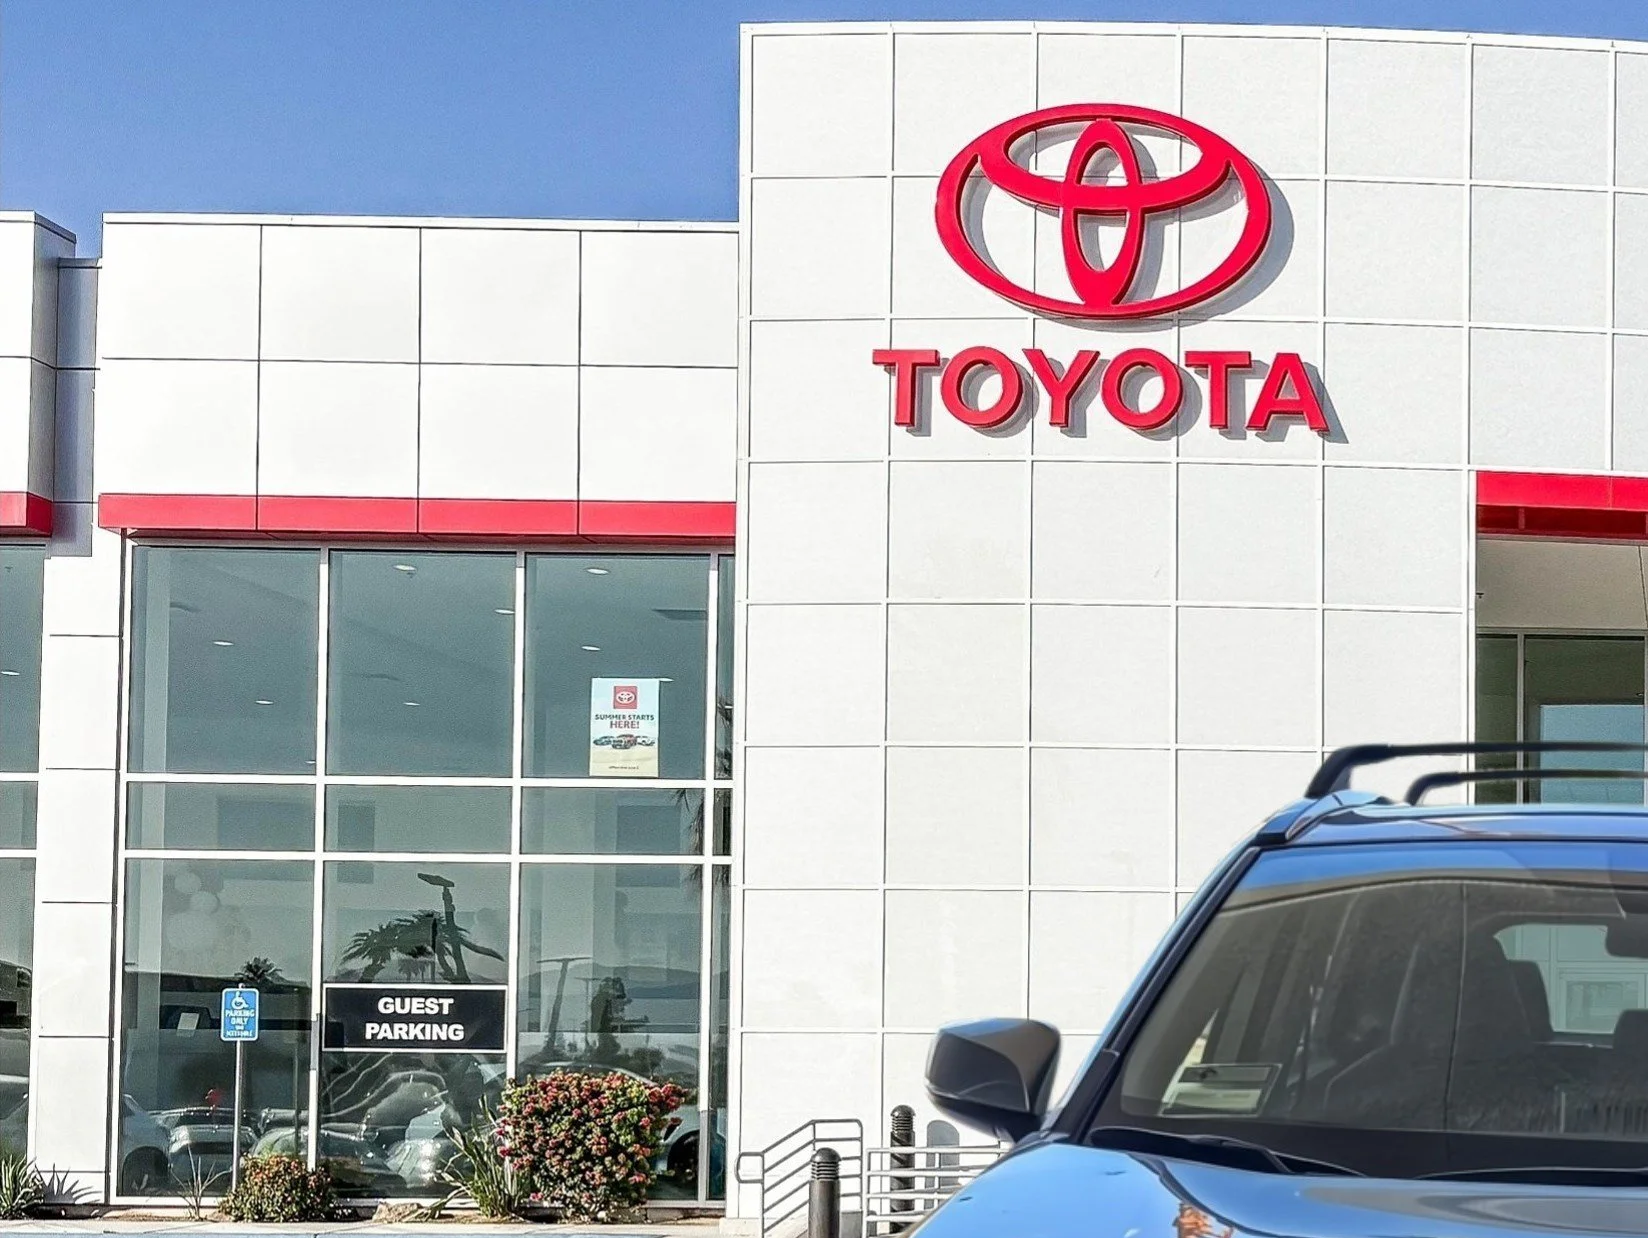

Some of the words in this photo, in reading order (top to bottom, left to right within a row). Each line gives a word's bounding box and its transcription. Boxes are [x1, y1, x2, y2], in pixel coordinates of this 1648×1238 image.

[872, 345, 1331, 434] TOYOTA
[609, 720, 640, 729] HERE!
[377, 997, 454, 1015] GUEST
[365, 1022, 464, 1041] PARKING
